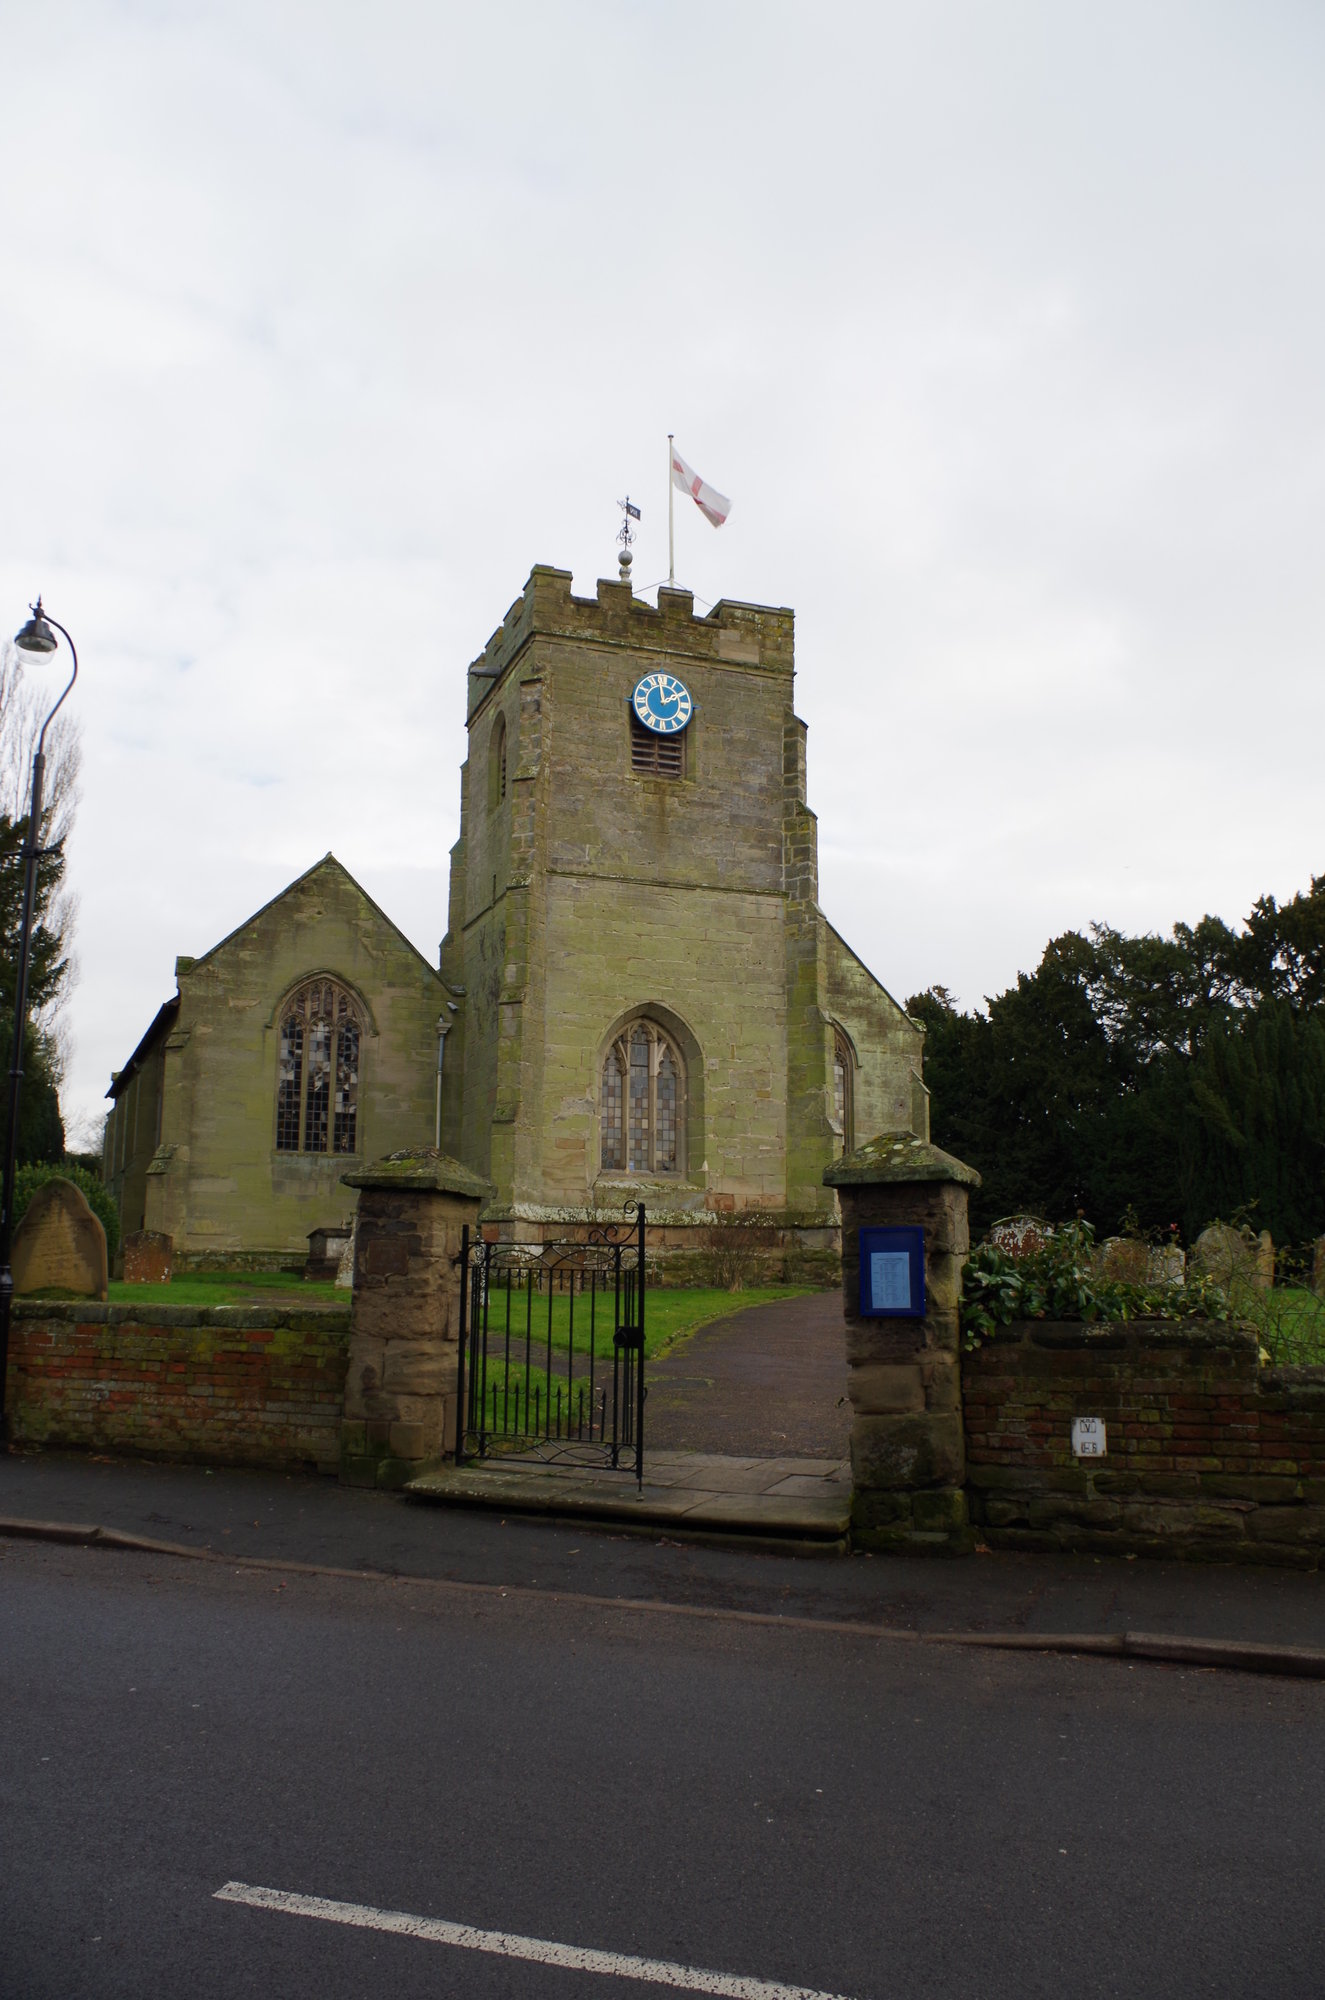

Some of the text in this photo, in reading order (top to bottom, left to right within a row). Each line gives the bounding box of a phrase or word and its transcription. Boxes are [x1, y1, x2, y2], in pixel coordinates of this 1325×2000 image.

[647, 677, 657, 687] XI
[671, 680, 677, 689] I
[639, 685, 649, 694] X
[680, 701, 689, 709] III
[638, 706, 649, 718] VIII
[647, 715, 656, 727] VII
[659, 720, 666, 731] VI
[671, 719, 678, 728] V
